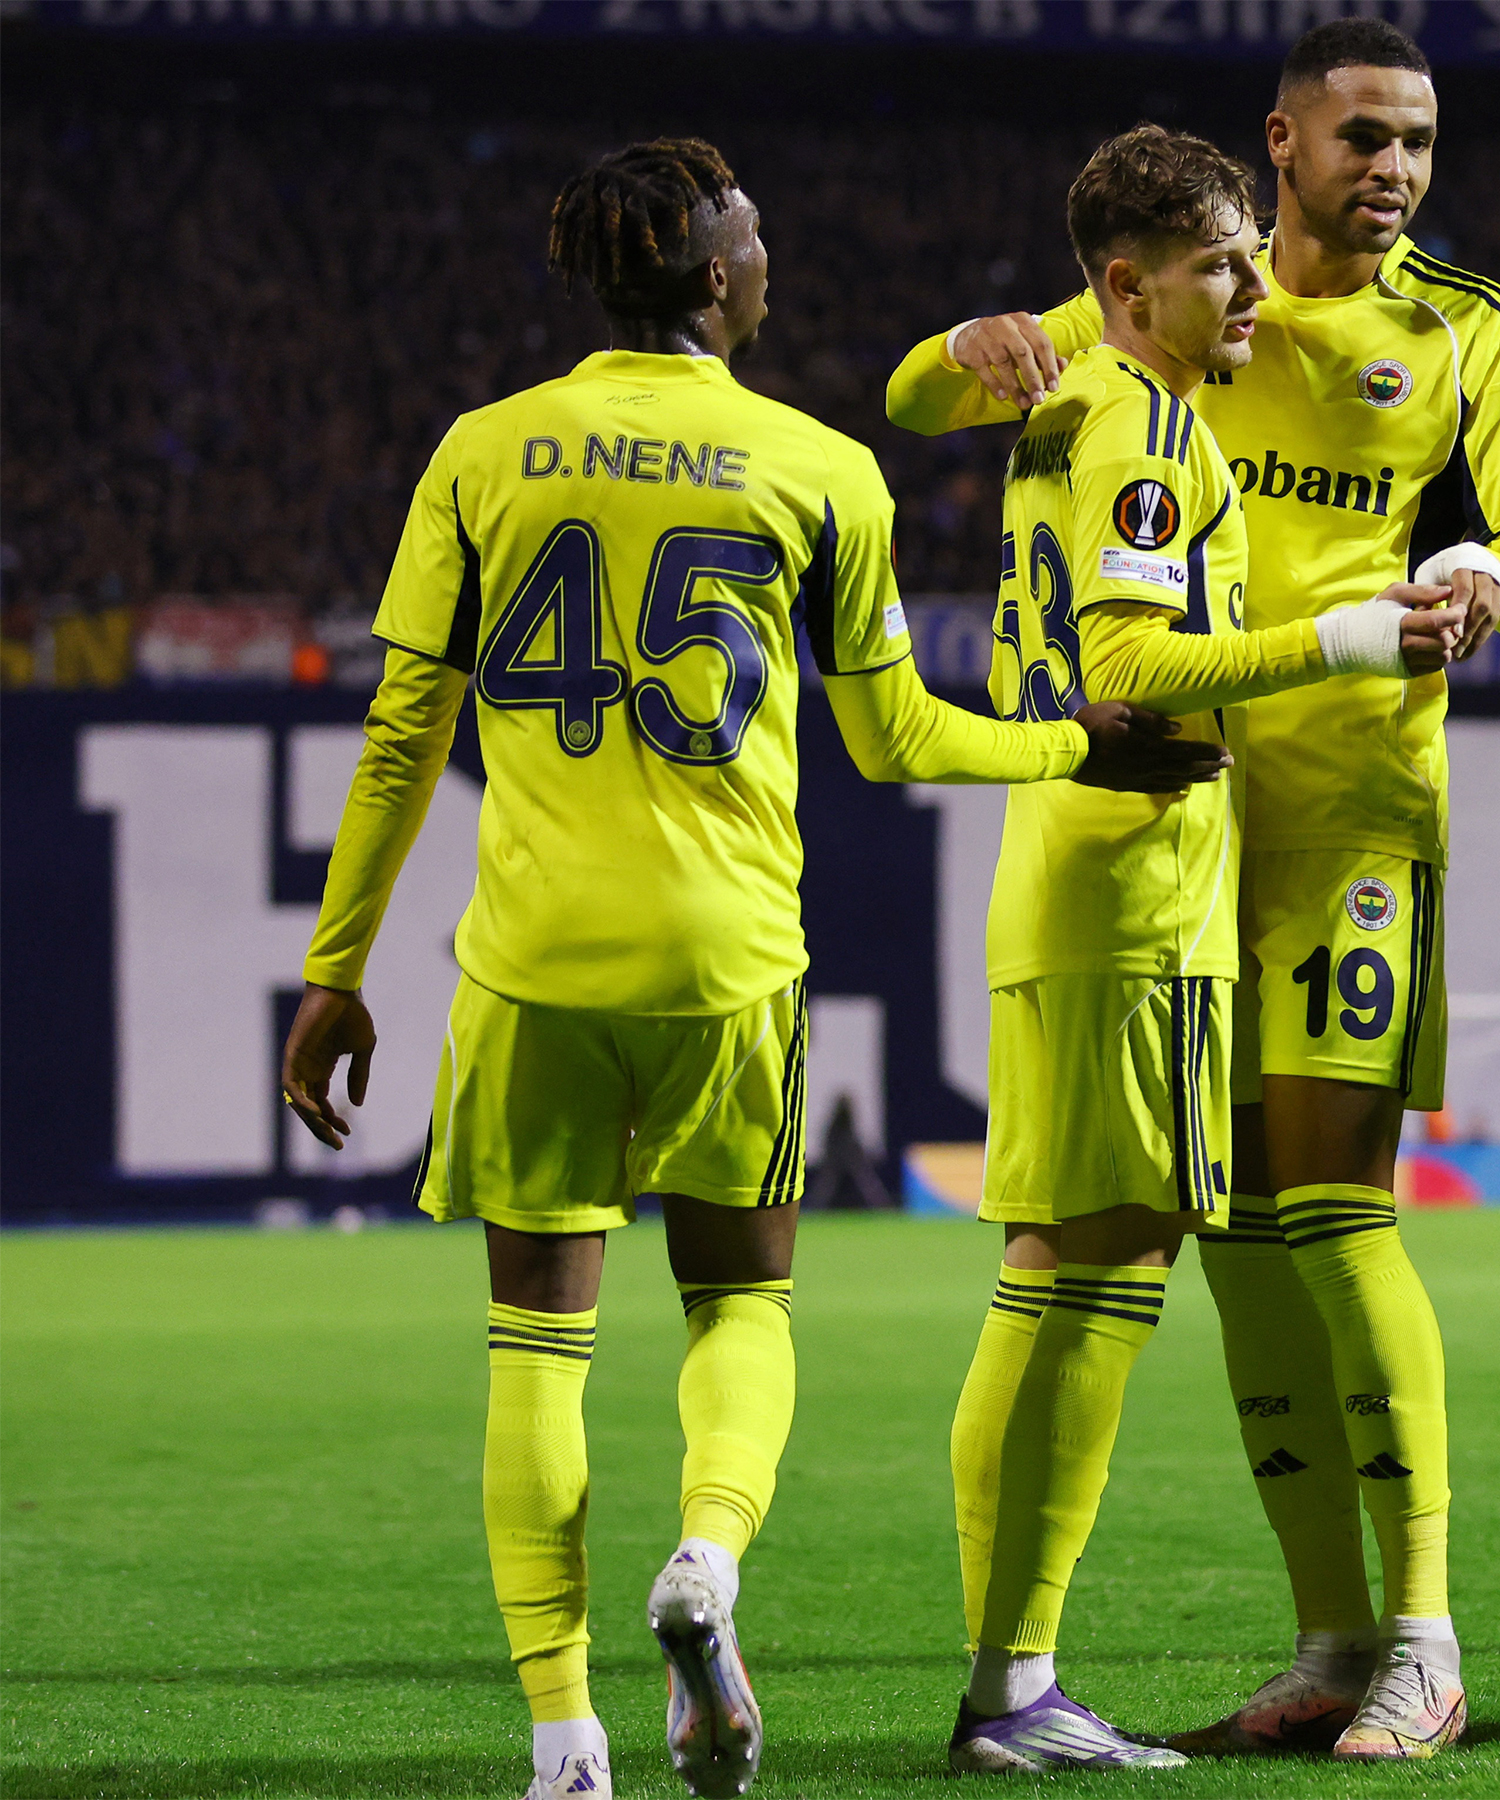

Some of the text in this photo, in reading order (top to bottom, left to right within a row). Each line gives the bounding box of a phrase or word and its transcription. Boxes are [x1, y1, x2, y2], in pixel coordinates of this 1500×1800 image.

[522, 432, 751, 491] D. NENE
[1228, 450, 1395, 516] obani
[1102, 558, 1165, 575] FOUNDATION
[476, 518, 785, 767] 45
[1292, 945, 1395, 1040] 19
